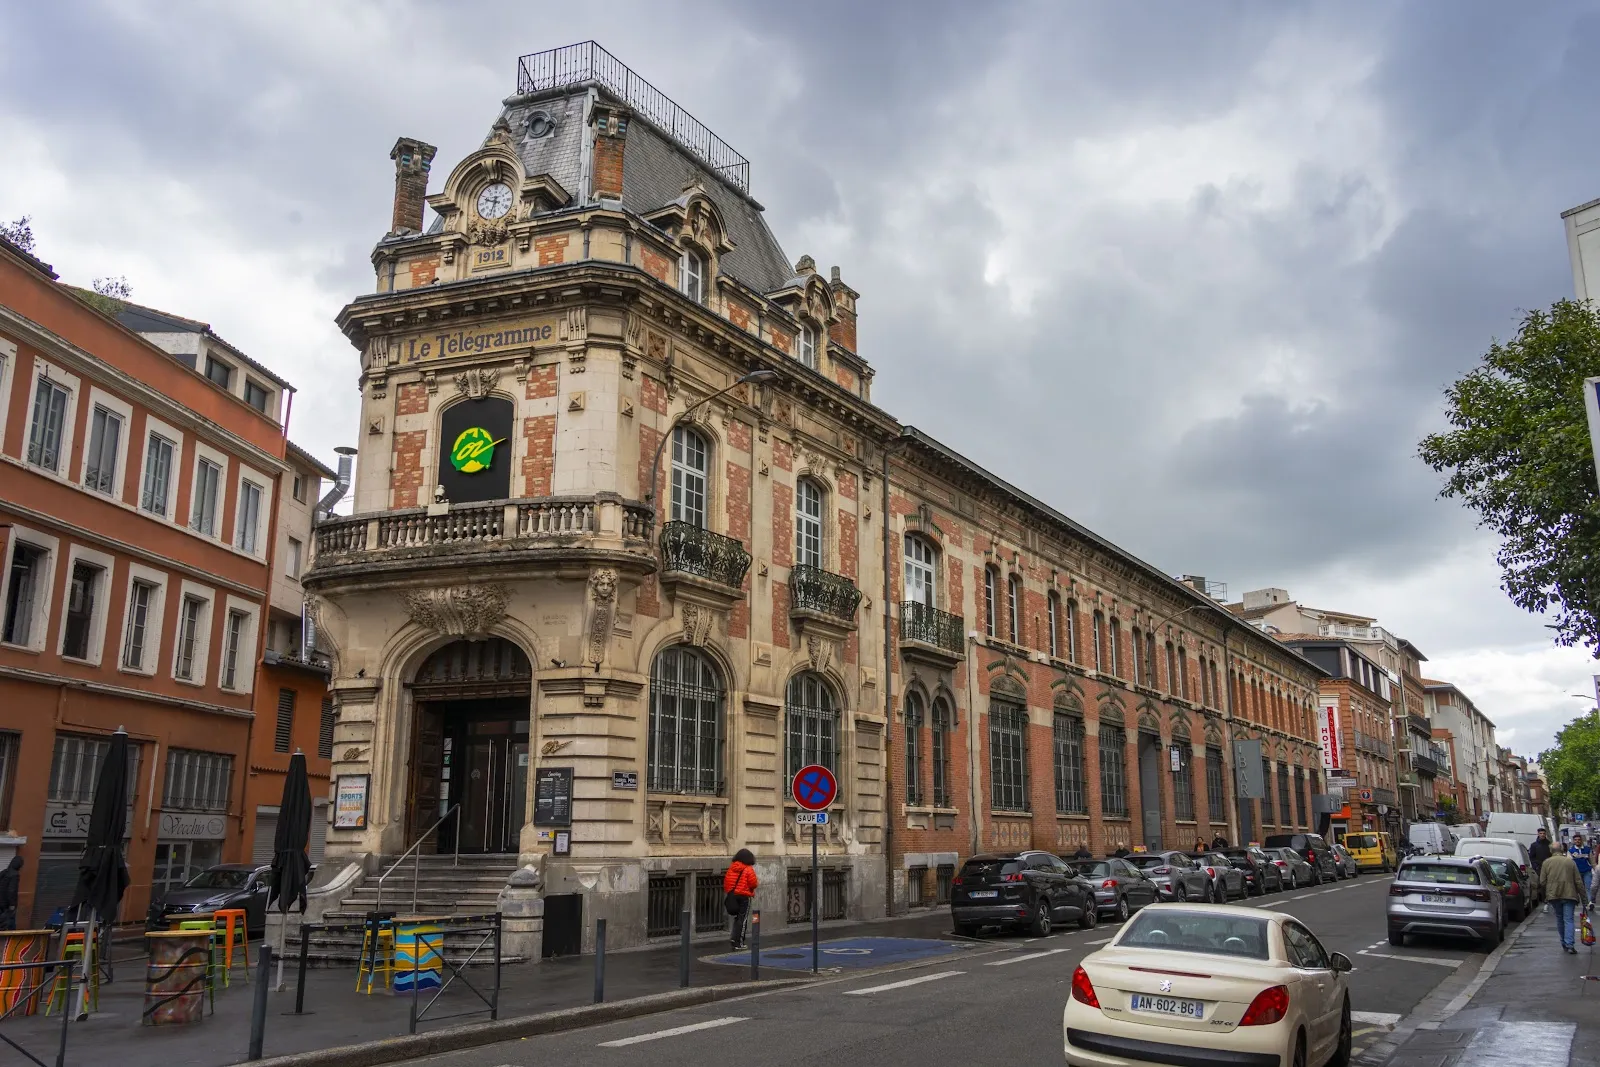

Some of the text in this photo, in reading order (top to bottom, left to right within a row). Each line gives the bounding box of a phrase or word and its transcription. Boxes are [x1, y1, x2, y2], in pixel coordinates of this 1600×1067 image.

[477, 250, 505, 263] 1912
[407, 325, 552, 362] Le Télégramme
[1321, 727, 1331, 765] HOTEL
[340, 792, 363, 800] SPORTS
[163, 815, 205, 835] Vecchio
[1139, 996, 1195, 1015] AN-602-BG
